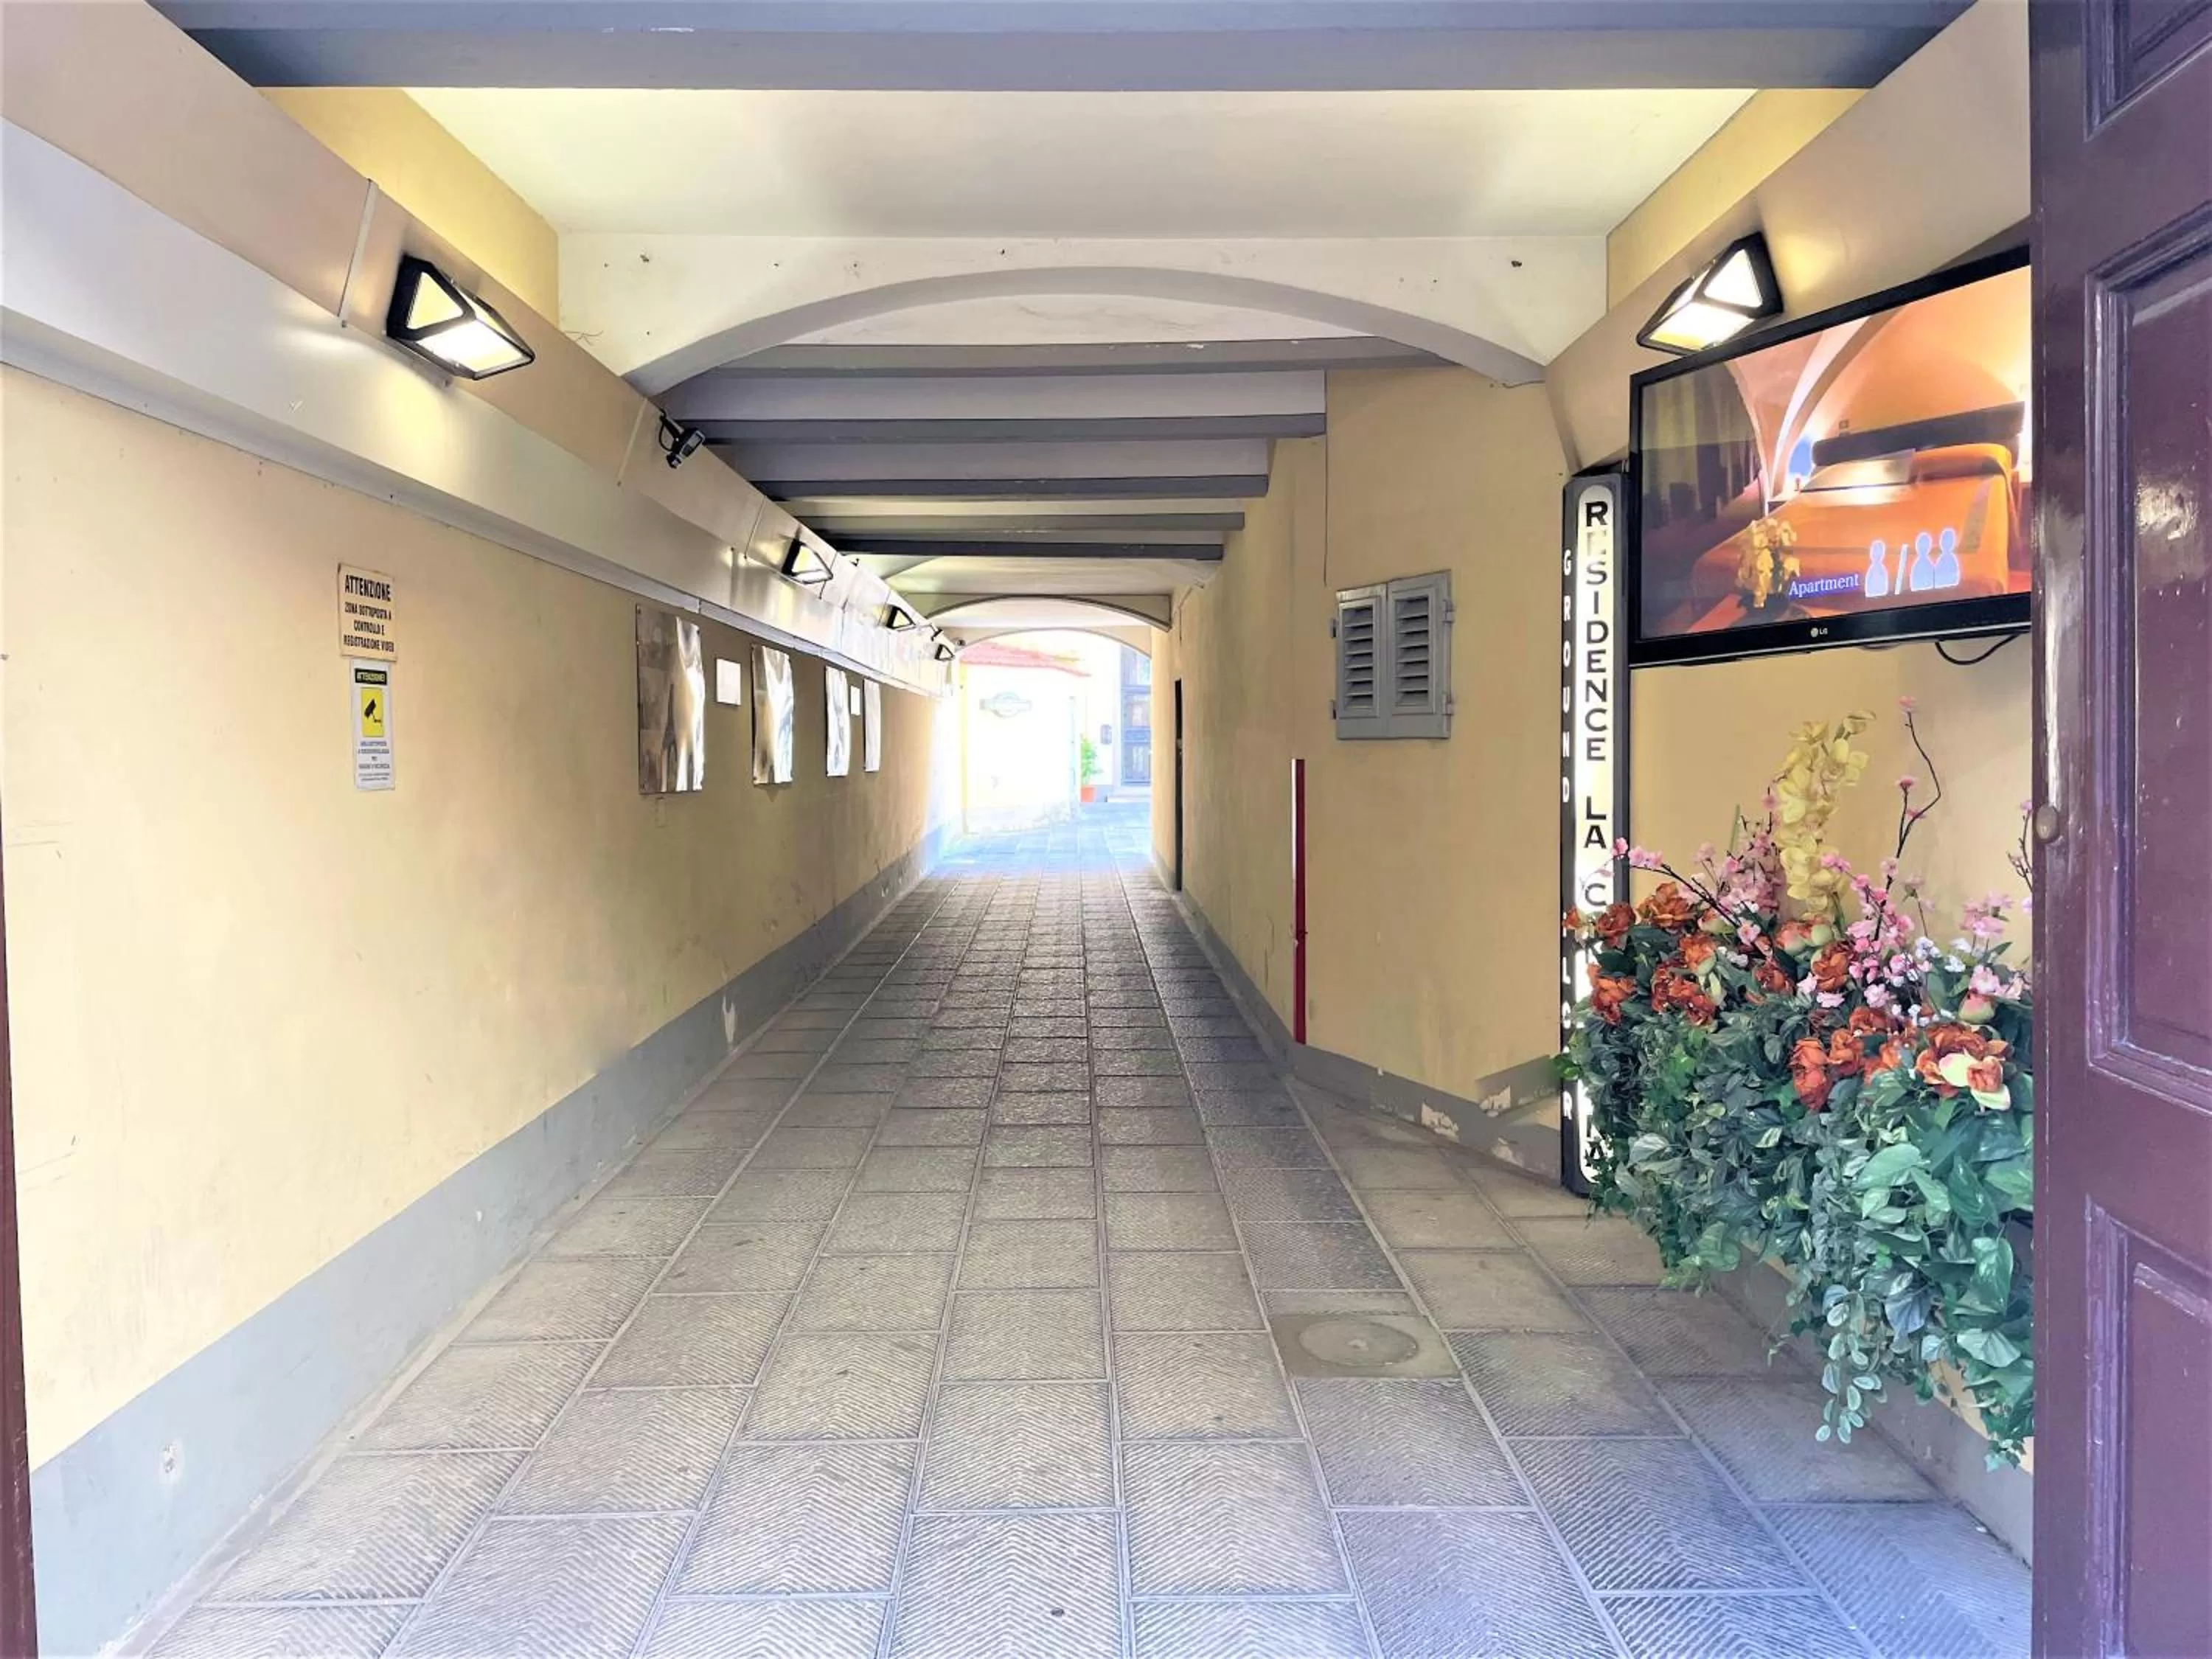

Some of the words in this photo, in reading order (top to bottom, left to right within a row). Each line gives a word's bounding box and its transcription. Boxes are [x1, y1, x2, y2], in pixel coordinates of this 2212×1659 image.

[345, 574, 391, 602] ATTENZIONE
[1789, 573, 1860, 598] Apartment
[344, 601, 358, 614] ZONA
[344, 635, 380, 650] REGISTRAZIONE
[381, 641, 394, 653] VIDEO
[1585, 501, 1609, 761] RESIDENCE
[1562, 549, 1572, 803] GROUND
[1585, 796, 1607, 849] LA
